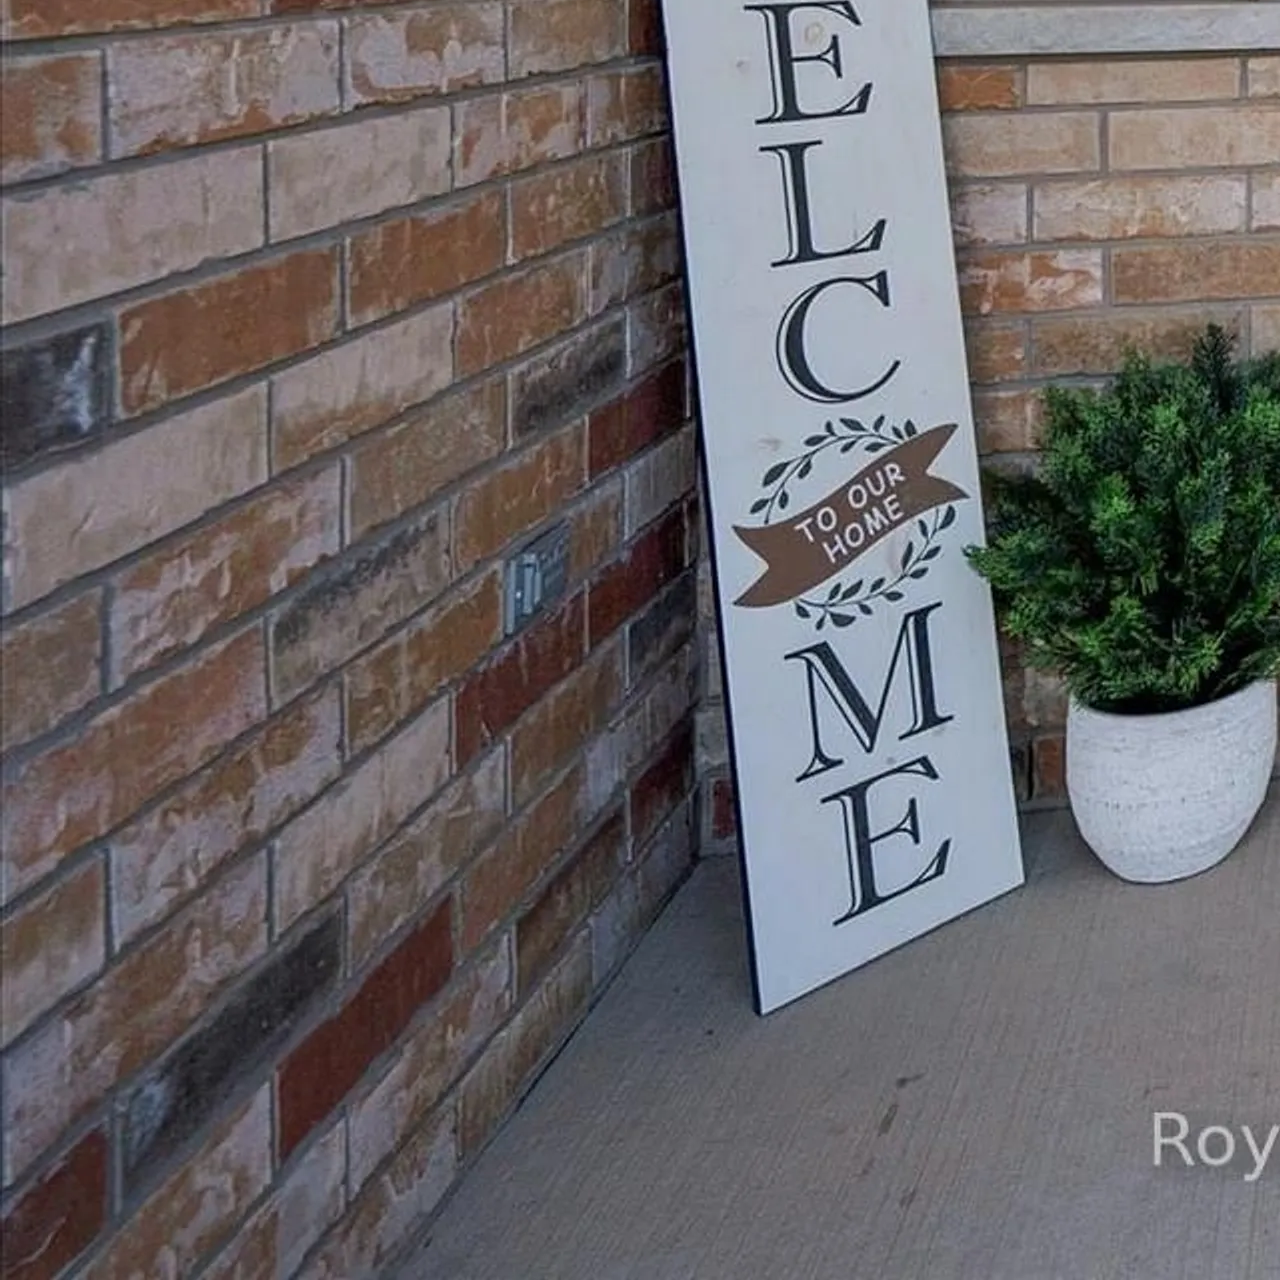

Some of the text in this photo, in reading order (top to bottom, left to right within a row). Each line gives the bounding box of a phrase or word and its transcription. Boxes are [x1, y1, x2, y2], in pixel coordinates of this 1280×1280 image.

[794, 462, 906, 543] TO OUR
[822, 494, 904, 563] HOME
